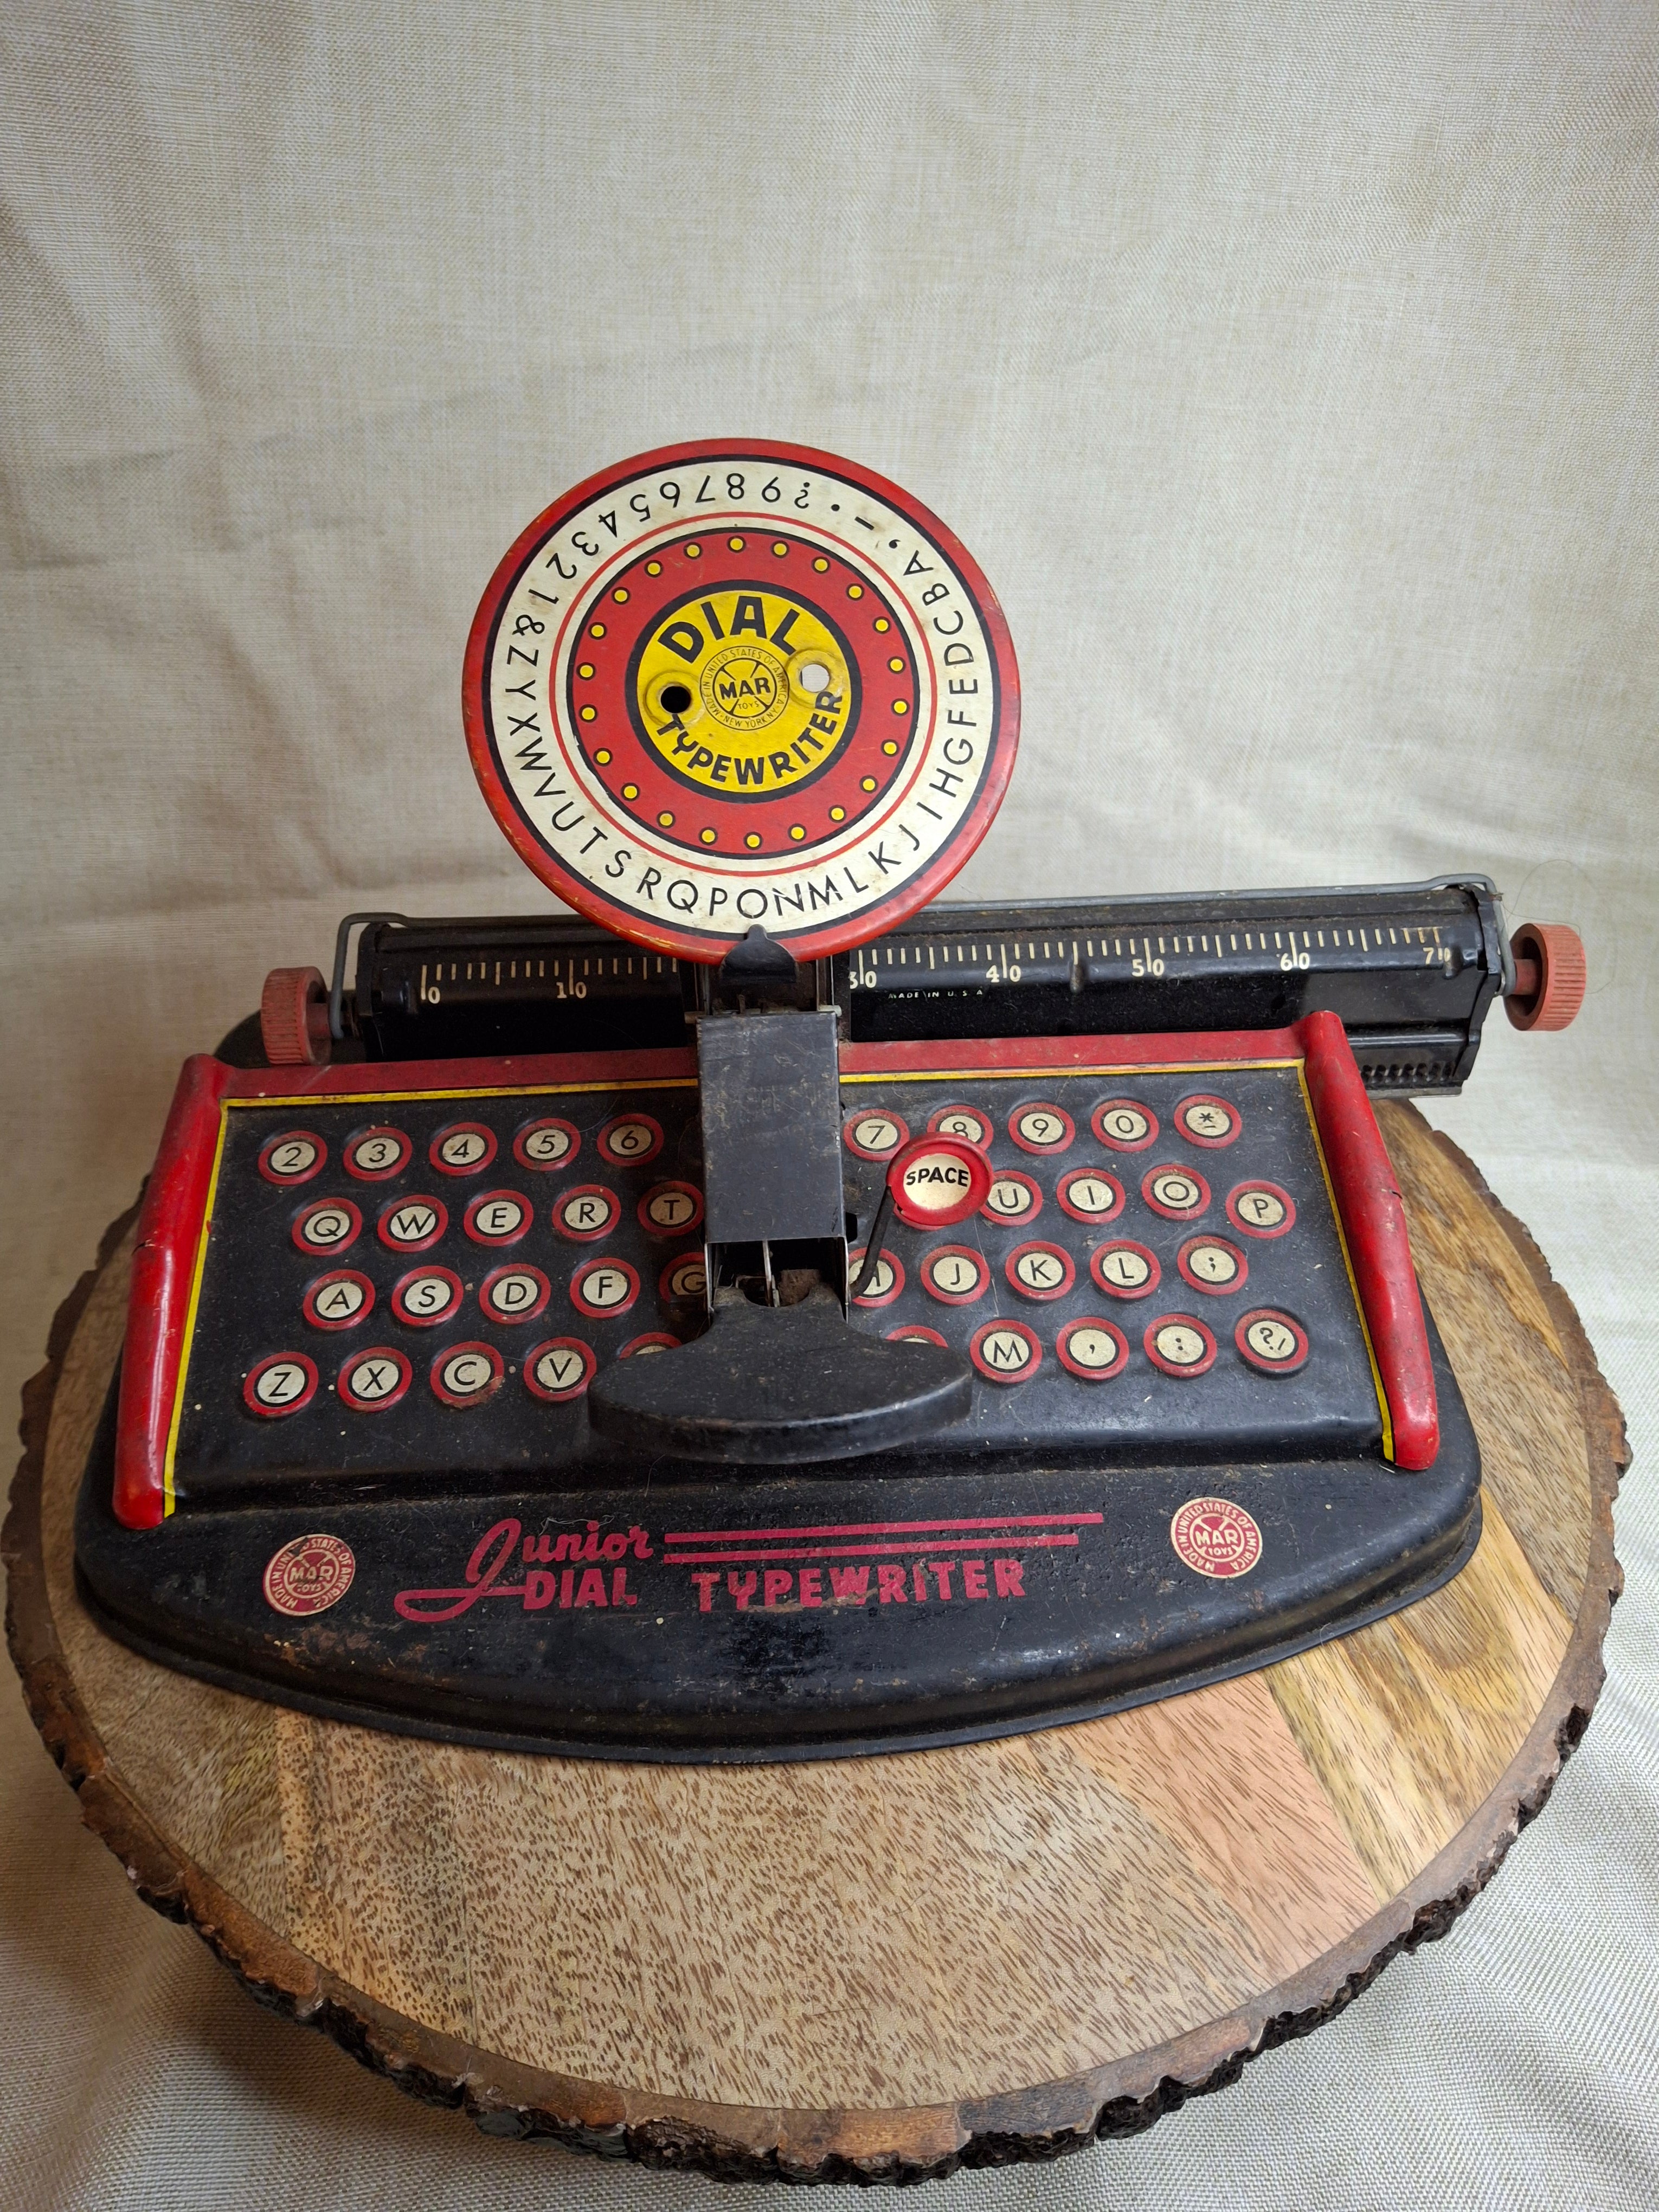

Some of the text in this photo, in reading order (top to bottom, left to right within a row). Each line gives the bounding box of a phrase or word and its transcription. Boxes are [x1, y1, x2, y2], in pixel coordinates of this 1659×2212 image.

[659, 481, 680, 509] 6
[695, 475, 716, 503] 7
[726, 473, 745, 500] 8
[761, 476, 781, 503] 9
[793, 481, 811, 510] ?
[629, 494, 651, 523] 5
[598, 510, 618, 538] 4
[571, 531, 599, 556] 3
[545, 552, 577, 580] 2
[903, 550, 934, 576] A
[528, 589, 560, 605] 1
[922, 583, 950, 606] B
[512, 614, 545, 636] &
[658, 595, 800, 664] DIAL
[933, 610, 963, 635] C
[506, 645, 539, 667] Z
[944, 643, 974, 666] D
[505, 679, 536, 701] Y
[702, 648, 787, 716] MADE IN UNITED STATES OF AMERICA
[719, 677, 771, 700] MAR
[949, 679, 978, 695] E
[737, 701, 759, 710] TOYS
[948, 710, 976, 726] F
[507, 712, 541, 736] X
[723, 715, 742, 727] NEW
[657, 691, 843, 785] TYPEWRITER
[943, 738, 973, 765] G
[515, 736, 552, 770] W
[533, 772, 567, 797] V
[929, 768, 963, 798] H
[551, 801, 586, 832] U
[917, 802, 942, 820] I
[580, 826, 608, 854] T
[899, 824, 919, 851] J
[605, 850, 632, 878] S
[868, 841, 901, 874] K
[636, 867, 661, 901] R
[807, 874, 844, 911] M
[844, 867, 869, 893] L
[667, 879, 698, 914] Q
[709, 887, 728, 916] P
[736, 889, 768, 919] O
[773, 883, 805, 916] N
[427, 986, 441, 1004] 0
[281, 1146, 302, 1167] 2
[368, 1143, 387, 1163] 3
[451, 1139, 470, 1158] 4
[537, 1134, 556, 1154] 5
[621, 1130, 639, 1150] 6
[867, 1125, 886, 1144] 7
[952, 1121, 969, 1139] 8
[1032, 1118, 1049, 1137] 9
[906, 1167, 969, 1187] SPACE
[313, 1216, 341, 1237] Q
[397, 1212, 434, 1236] W
[490, 1207, 508, 1229] E
[579, 1202, 596, 1224] R
[663, 1199, 680, 1220] T
[997, 1188, 1019, 1209] U
[1162, 1181, 1190, 1202] O
[1252, 1198, 1269, 1219] P
[325, 1288, 350, 1311] A
[418, 1285, 436, 1308] S
[505, 1282, 527, 1305] D
[598, 1276, 613, 1299] F
[681, 1271, 706, 1294] G
[950, 1263, 961, 1285] J
[1030, 1259, 1052, 1281] K
[1118, 1257, 1135, 1279] L
[268, 1372, 292, 1397] Z
[362, 1366, 387, 1391] X
[454, 1361, 477, 1386] C
[549, 1357, 573, 1382] V
[993, 1340, 1023, 1364] M
[1178, 1502, 1257, 1572] MADE IN UNITED STATES OF AMERICA
[1195, 1529, 1239, 1545] MAR
[1208, 1546, 1233, 1555] TOYS
[338, 1553, 352, 1566] OF
[394, 1518, 653, 1622] Junior
[272, 1572, 283, 1584] IN
[290, 1566, 334, 1582] MAR
[313, 1567, 352, 1607] AMERICA
[523, 1558, 1026, 1612] DIAL TYPEWRITER
[273, 1584, 298, 1609] MADE
